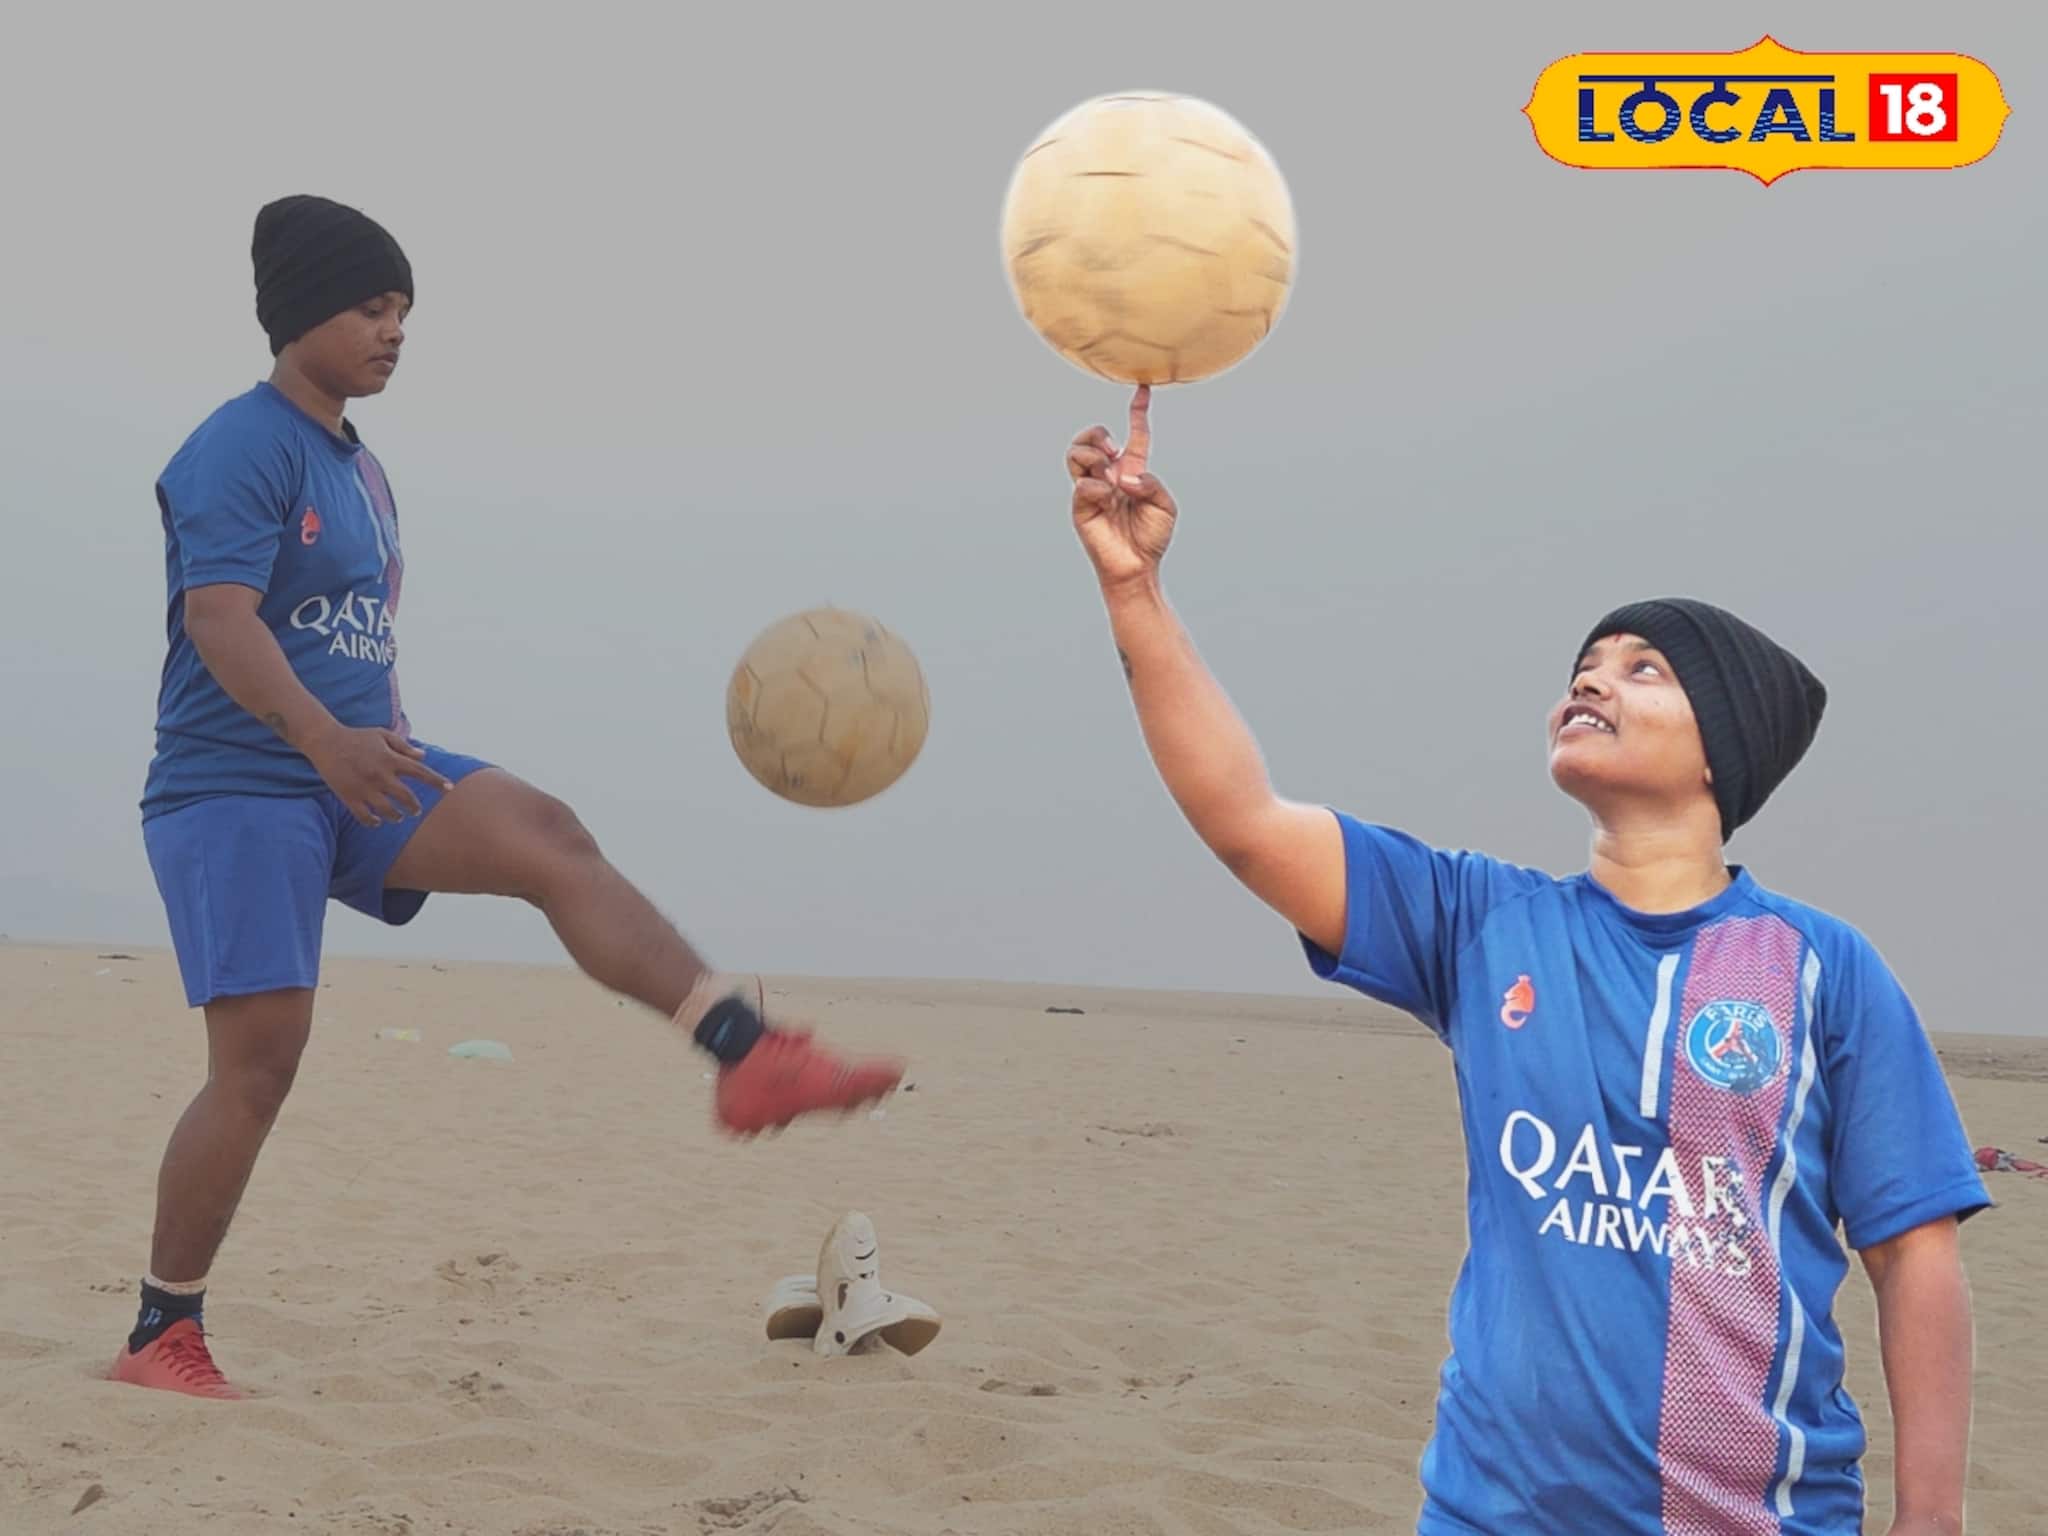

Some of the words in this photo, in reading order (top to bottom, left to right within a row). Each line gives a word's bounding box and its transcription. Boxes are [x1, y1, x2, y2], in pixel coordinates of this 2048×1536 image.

[290, 591, 396, 637] QATA
[328, 630, 398, 666] AIRW
[1500, 1110, 1747, 1226] QATAR
